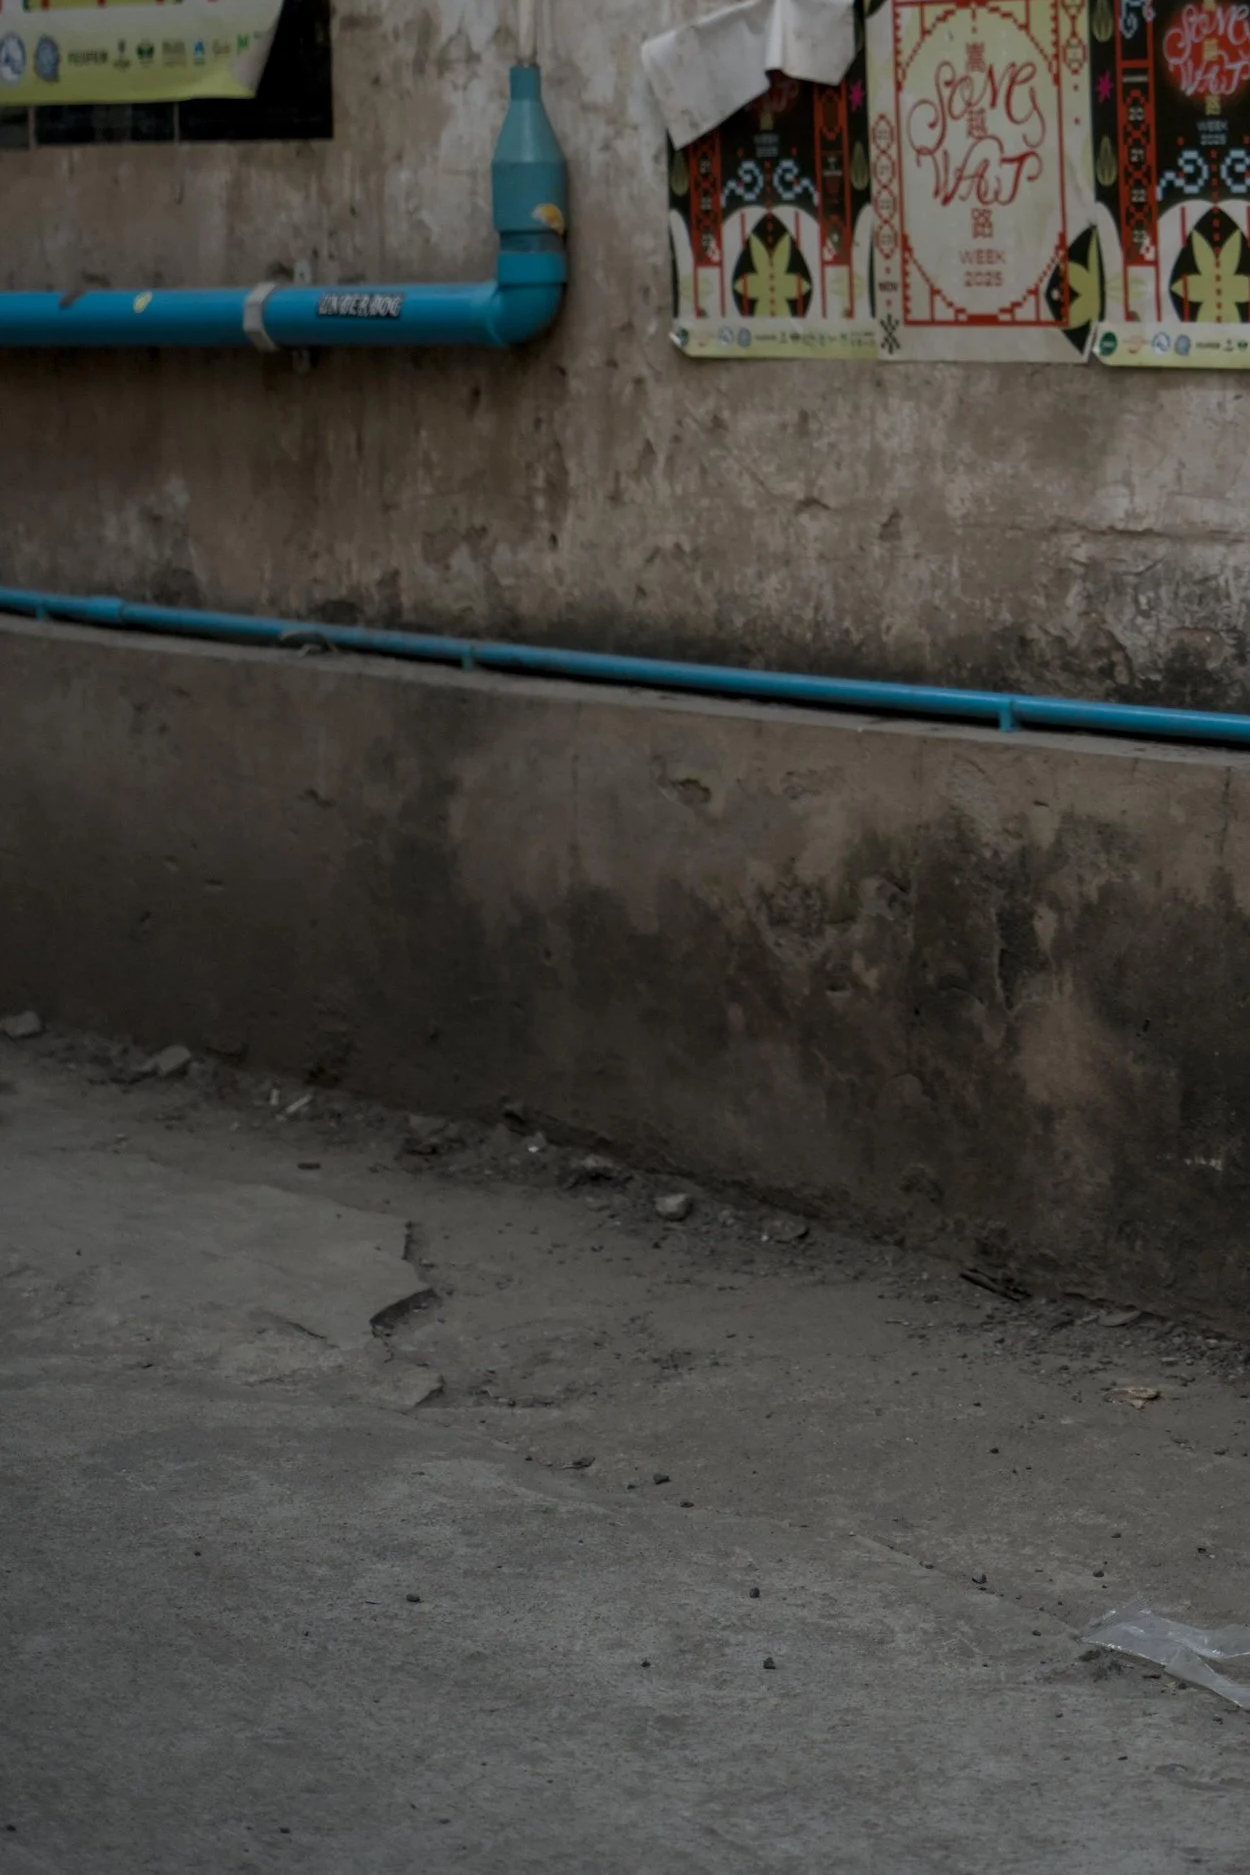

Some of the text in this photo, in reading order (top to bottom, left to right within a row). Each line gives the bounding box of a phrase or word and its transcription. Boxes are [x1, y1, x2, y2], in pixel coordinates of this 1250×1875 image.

[907, 60, 1046, 156] SONG
[915, 134, 1042, 207] WAT
[959, 249, 1006, 265] WEEK
[318, 292, 401, 317] UNDERDOG
